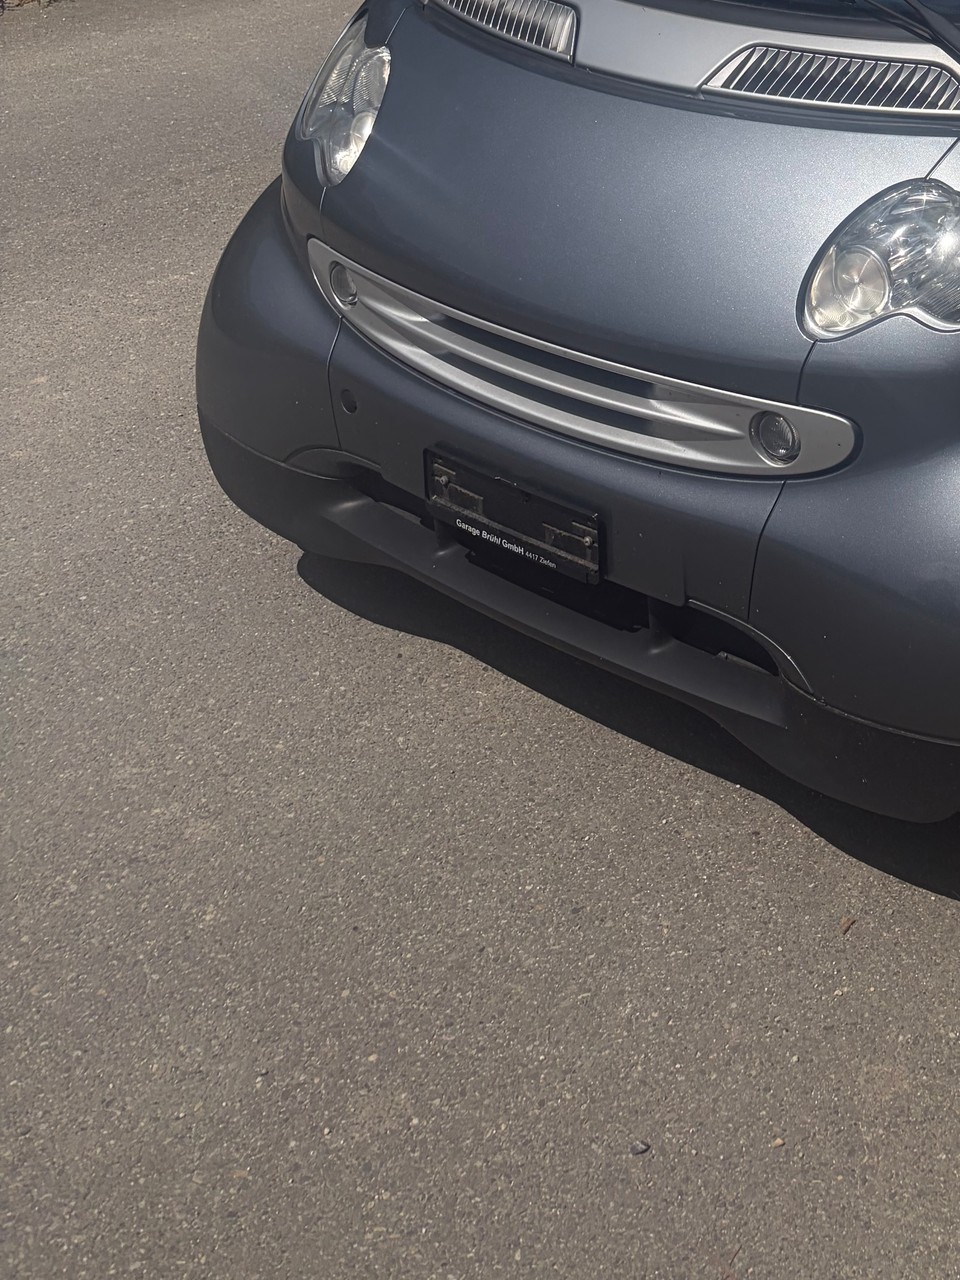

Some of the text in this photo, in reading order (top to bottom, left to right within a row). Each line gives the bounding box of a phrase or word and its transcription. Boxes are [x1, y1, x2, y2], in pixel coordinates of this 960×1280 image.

[455, 518, 557, 569] Garage Brühl GmbH 4417 Ziefen
